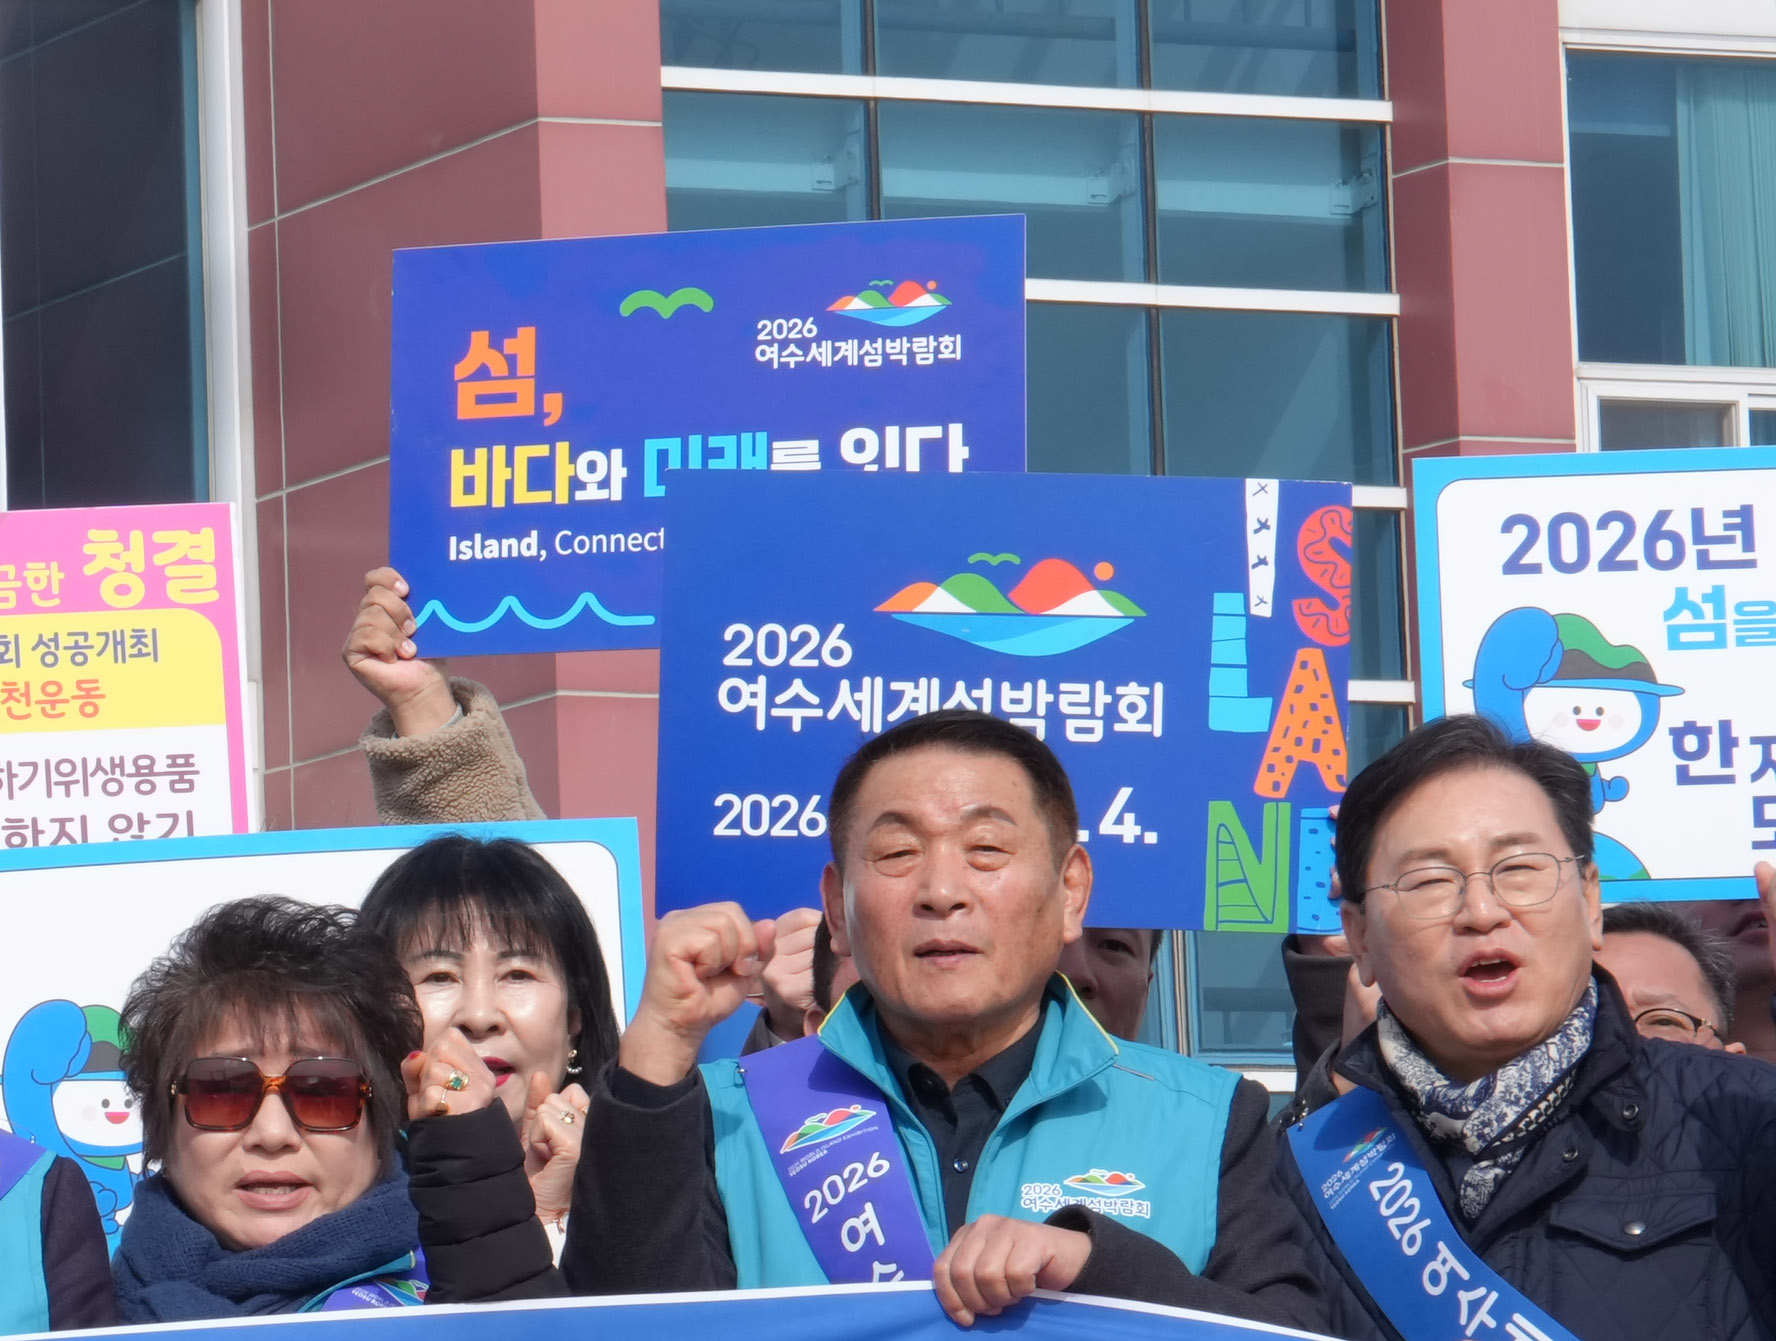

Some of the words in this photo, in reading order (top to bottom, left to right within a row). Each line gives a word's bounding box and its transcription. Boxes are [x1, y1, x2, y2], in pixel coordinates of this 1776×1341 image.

[755, 333, 962, 369] 여수세계섬박람회
[757, 318, 817, 339] 2026
[454, 327, 563, 426] 섬,
[450, 441, 627, 508] 바다와
[82, 527, 219, 607] 청결
[449, 530, 547, 562] Island,
[1500, 504, 1758, 575] 2026년
[30, 628, 158, 674] 성공개최
[722, 623, 852, 667] 2026
[804, 1152, 891, 1224] 2026
[1023, 1184, 1061, 1196] 2026
[1369, 1162, 1432, 1256] 2026
